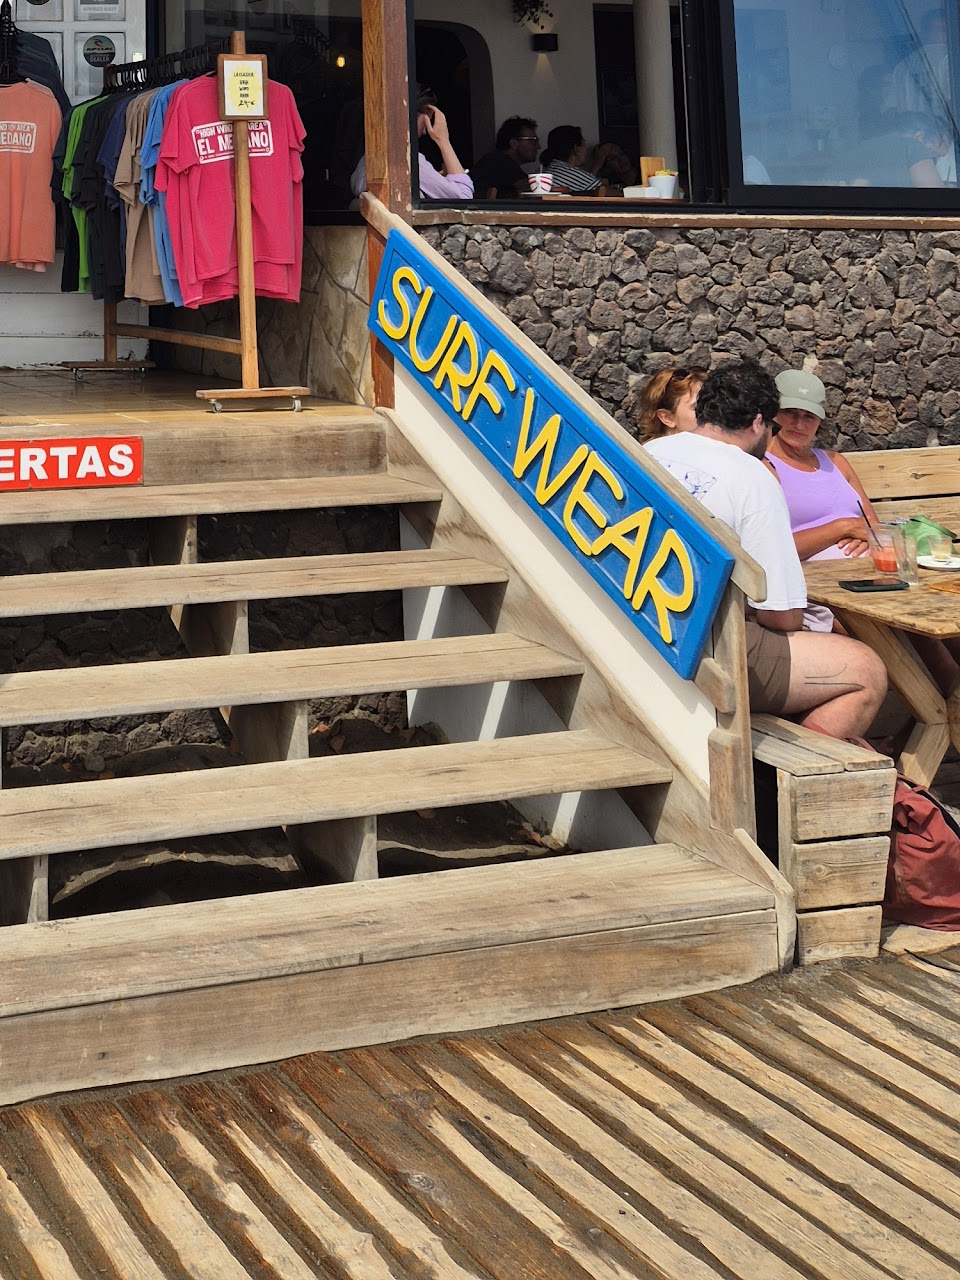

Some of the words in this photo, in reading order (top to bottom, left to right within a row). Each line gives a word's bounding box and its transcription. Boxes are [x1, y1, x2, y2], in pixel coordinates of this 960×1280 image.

[197, 138, 215, 155] EL
[378, 265, 516, 421] SURF
[512, 386, 695, 645] WEAR
